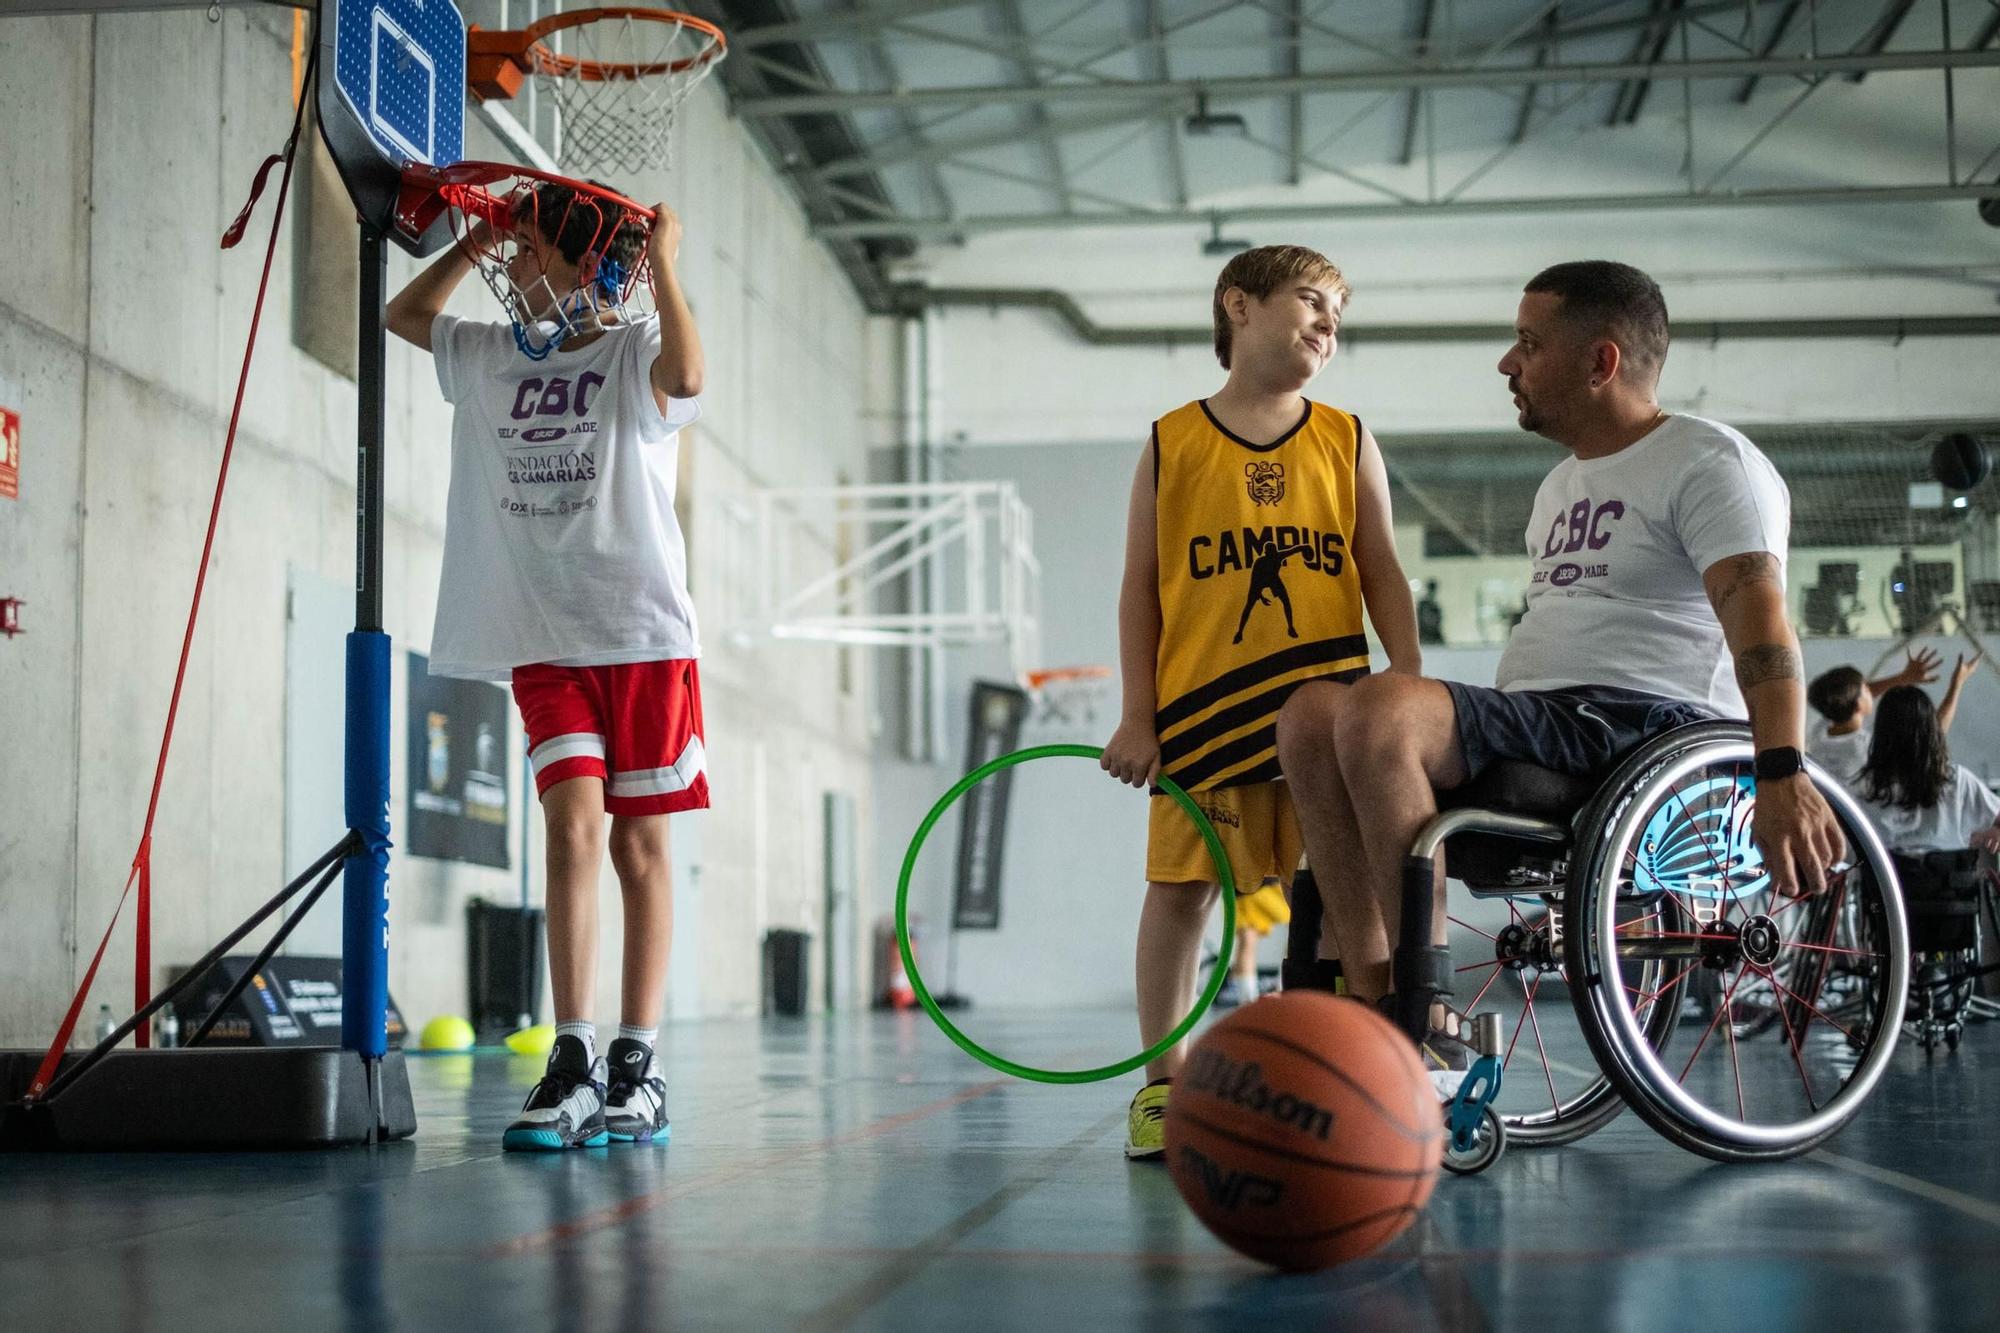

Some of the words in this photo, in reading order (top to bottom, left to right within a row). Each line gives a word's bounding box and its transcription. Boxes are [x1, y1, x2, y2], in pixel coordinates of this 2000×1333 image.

[511, 371, 606, 420] CBC
[521, 467, 596, 484] CANARIAS
[1189, 526, 1344, 580] CAMPUS
[1541, 498, 1625, 560] CBC
[1584, 564, 1609, 578] MADE
[1186, 1051, 1334, 1141] Wilson
